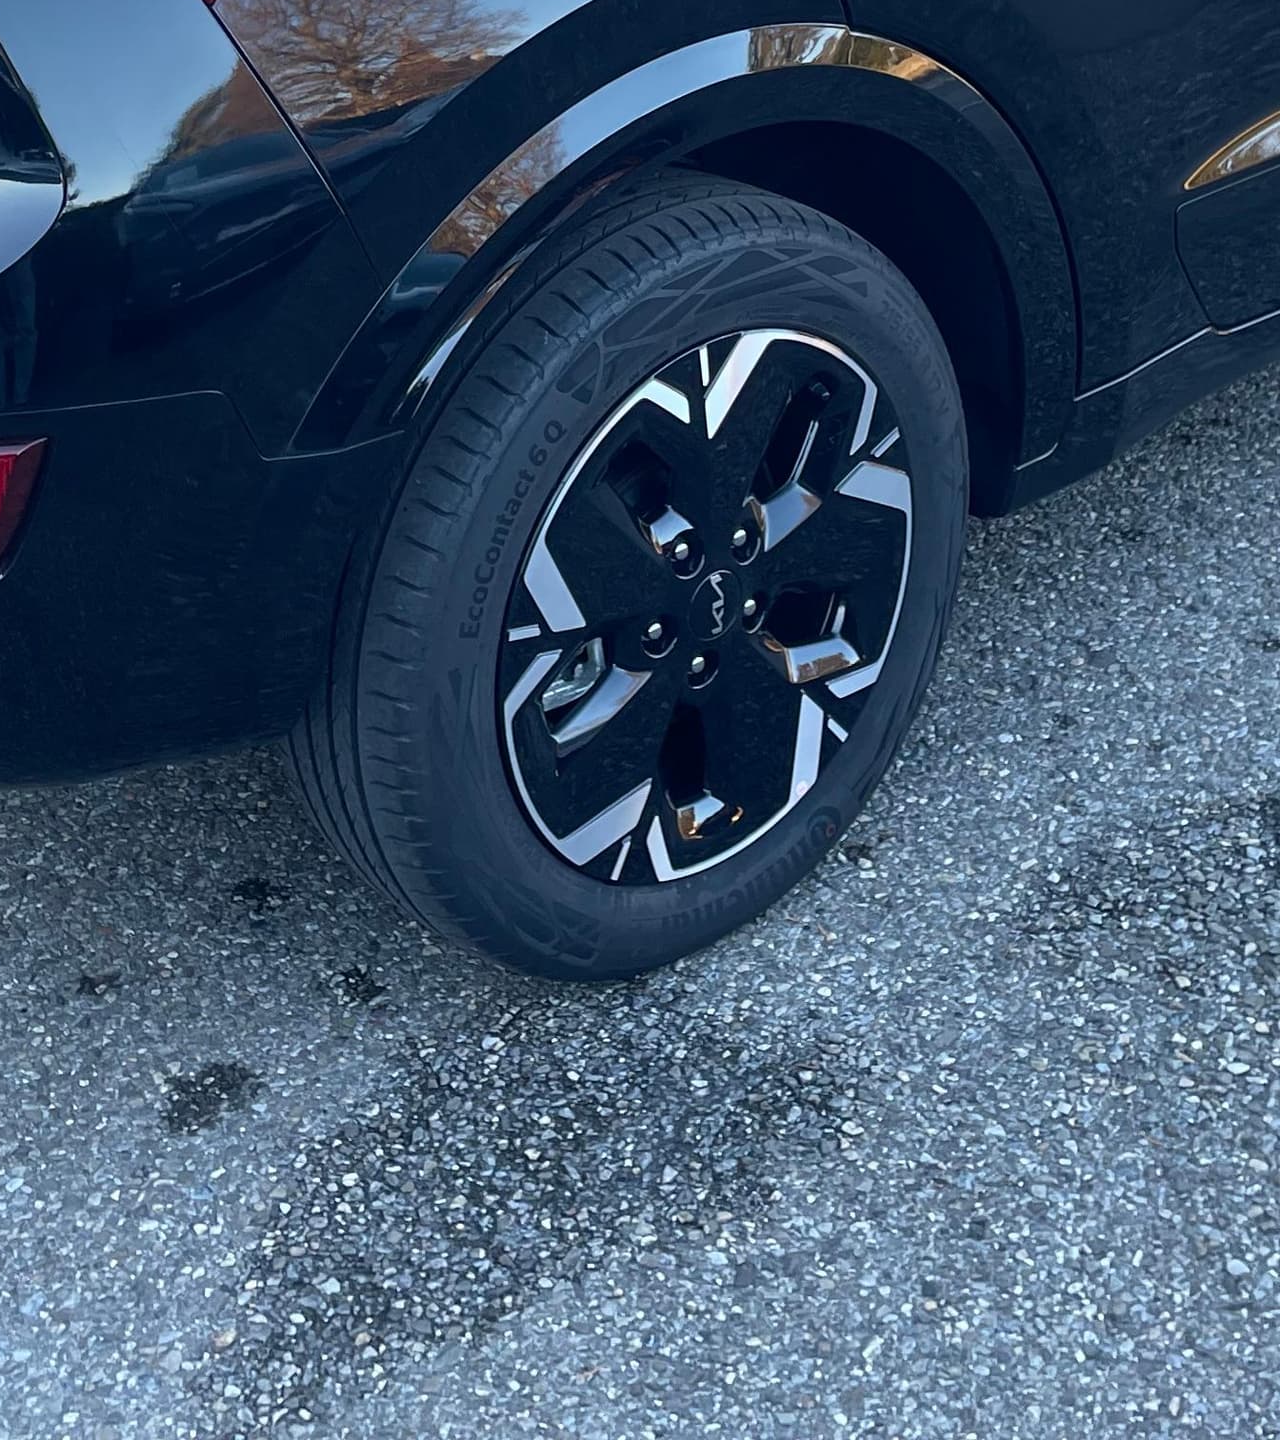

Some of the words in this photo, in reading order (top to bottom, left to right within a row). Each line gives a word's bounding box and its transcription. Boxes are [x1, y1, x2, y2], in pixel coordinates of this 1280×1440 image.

[459, 468, 536, 640] EcoContact
[528, 443, 548, 467] 6
[543, 419, 568, 445] Q
